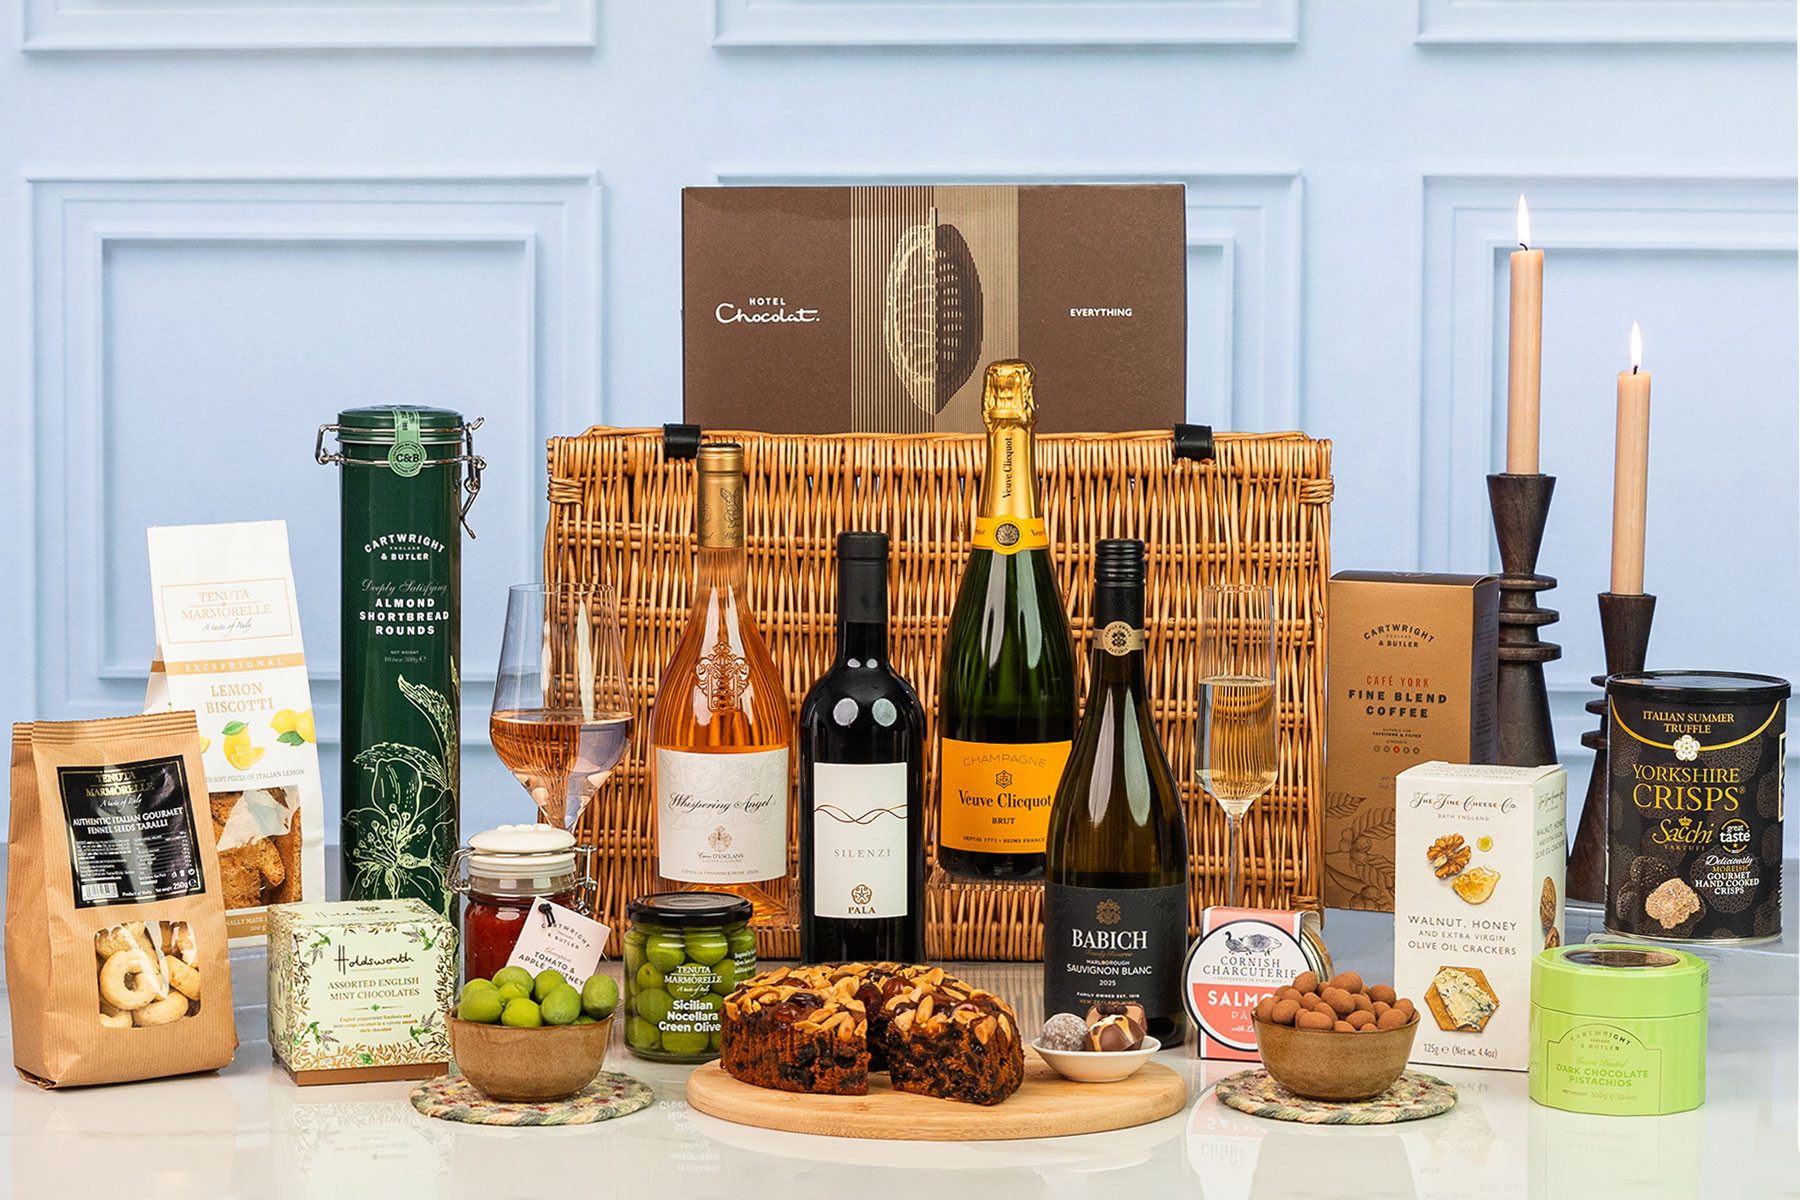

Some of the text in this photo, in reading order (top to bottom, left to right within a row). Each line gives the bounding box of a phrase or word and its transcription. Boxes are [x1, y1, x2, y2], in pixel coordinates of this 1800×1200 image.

[749, 297, 786, 306] HOTEL
[1070, 308, 1133, 317] EVERYTHING
[396, 453, 420, 462] C&B
[1002, 437, 1014, 498] Veuve Clicquot
[364, 533, 445, 553] CARTWRIGHT
[361, 578, 448, 596] Deeply Satisfying
[198, 589, 250, 602] TENUTA
[375, 598, 435, 608] ALMOND
[180, 604, 272, 620] MARMORELLE
[359, 611, 450, 622] SHORTBREAD
[375, 625, 435, 635] ROUNDS
[1363, 624, 1435, 643] CARTWRIGHT
[1387, 640, 1419, 648] BUTLER
[185, 657, 284, 672] EXCEPTIONAL
[1366, 675, 1430, 688] CAFÉ YORK
[210, 682, 263, 697] LEMON
[1348, 689, 1447, 704] FINE BLEND
[205, 697, 274, 714] BISCOTTI
[1366, 705, 1429, 718] COFFEE
[1643, 710, 1735, 723] ITALIAN SUMMER
[1663, 723, 1711, 734] TRUFFLE
[963, 753, 1046, 768] CHAMPAGNE
[96, 771, 136, 783] TENUTA
[256, 771, 282, 780] ITALIAN
[282, 768, 304, 777] LEMON
[1632, 763, 1740, 783] YORKSHIRE
[85, 781, 154, 797] MARMORELLE
[668, 792, 773, 815] Whispering Angel
[958, 789, 1051, 811] Veuve Clicquot
[73, 806, 184, 826] AUTHENTIC ITALIAN GOURMET
[992, 817, 1016, 825] BRUT
[87, 818, 168, 835] FENNEL SEEDS TARALLI
[1652, 818, 1713, 844] Sacchi
[1726, 824, 1744, 833] great
[1719, 832, 1751, 843] taste
[833, 849, 891, 858] SILENZI
[1705, 855, 1753, 867] Deliciously
[1712, 864, 1749, 873] MOREISH
[1707, 871, 1751, 880] GOURMET
[172, 881, 189, 890] 250g
[1695, 878, 1760, 888] HAND COOKED
[1713, 886, 1745, 895] CRISPS
[848, 906, 876, 915] PALA
[1408, 914, 1517, 931] WALNUT, HONEY
[541, 922, 590, 949] CRTWRIGHT
[1072, 929, 1148, 950] BABICH
[1418, 929, 1506, 942] AND EXTRA VIRGIN
[554, 935, 579, 950] BUTLER
[1407, 940, 1517, 956] OLIVE OIL CRACKERS
[333, 944, 415, 975] Holdsworth
[518, 953, 546, 970] APPLE
[534, 951, 568, 971] TOMATO
[1220, 956, 1280, 968] CORNISH
[676, 965, 711, 974] TENUTA
[1066, 963, 1152, 976] SAUVIGNON BLANC
[1203, 965, 1297, 979] CHARCUTERIE
[328, 977, 419, 990] ASSORTED ENGLISH
[664, 975, 723, 984] MARMORELLE
[329, 988, 420, 1001] MINT CHOCOLATES
[1208, 989, 1274, 1007] SALM
[673, 1000, 713, 1010] Sicilian
[667, 1010, 719, 1021] Nocellara
[1231, 1010, 1248, 1020] PÂ
[658, 1021, 721, 1032] Green Olive
[1570, 1031, 1631, 1045] CARTWRIGHT
[1423, 1043, 1439, 1056] 125g
[1589, 1043, 1620, 1051] BUTLER
[1556, 1063, 1649, 1079] DARK CHOCOLATE
[1569, 1074, 1633, 1087] PISTACHIOS
